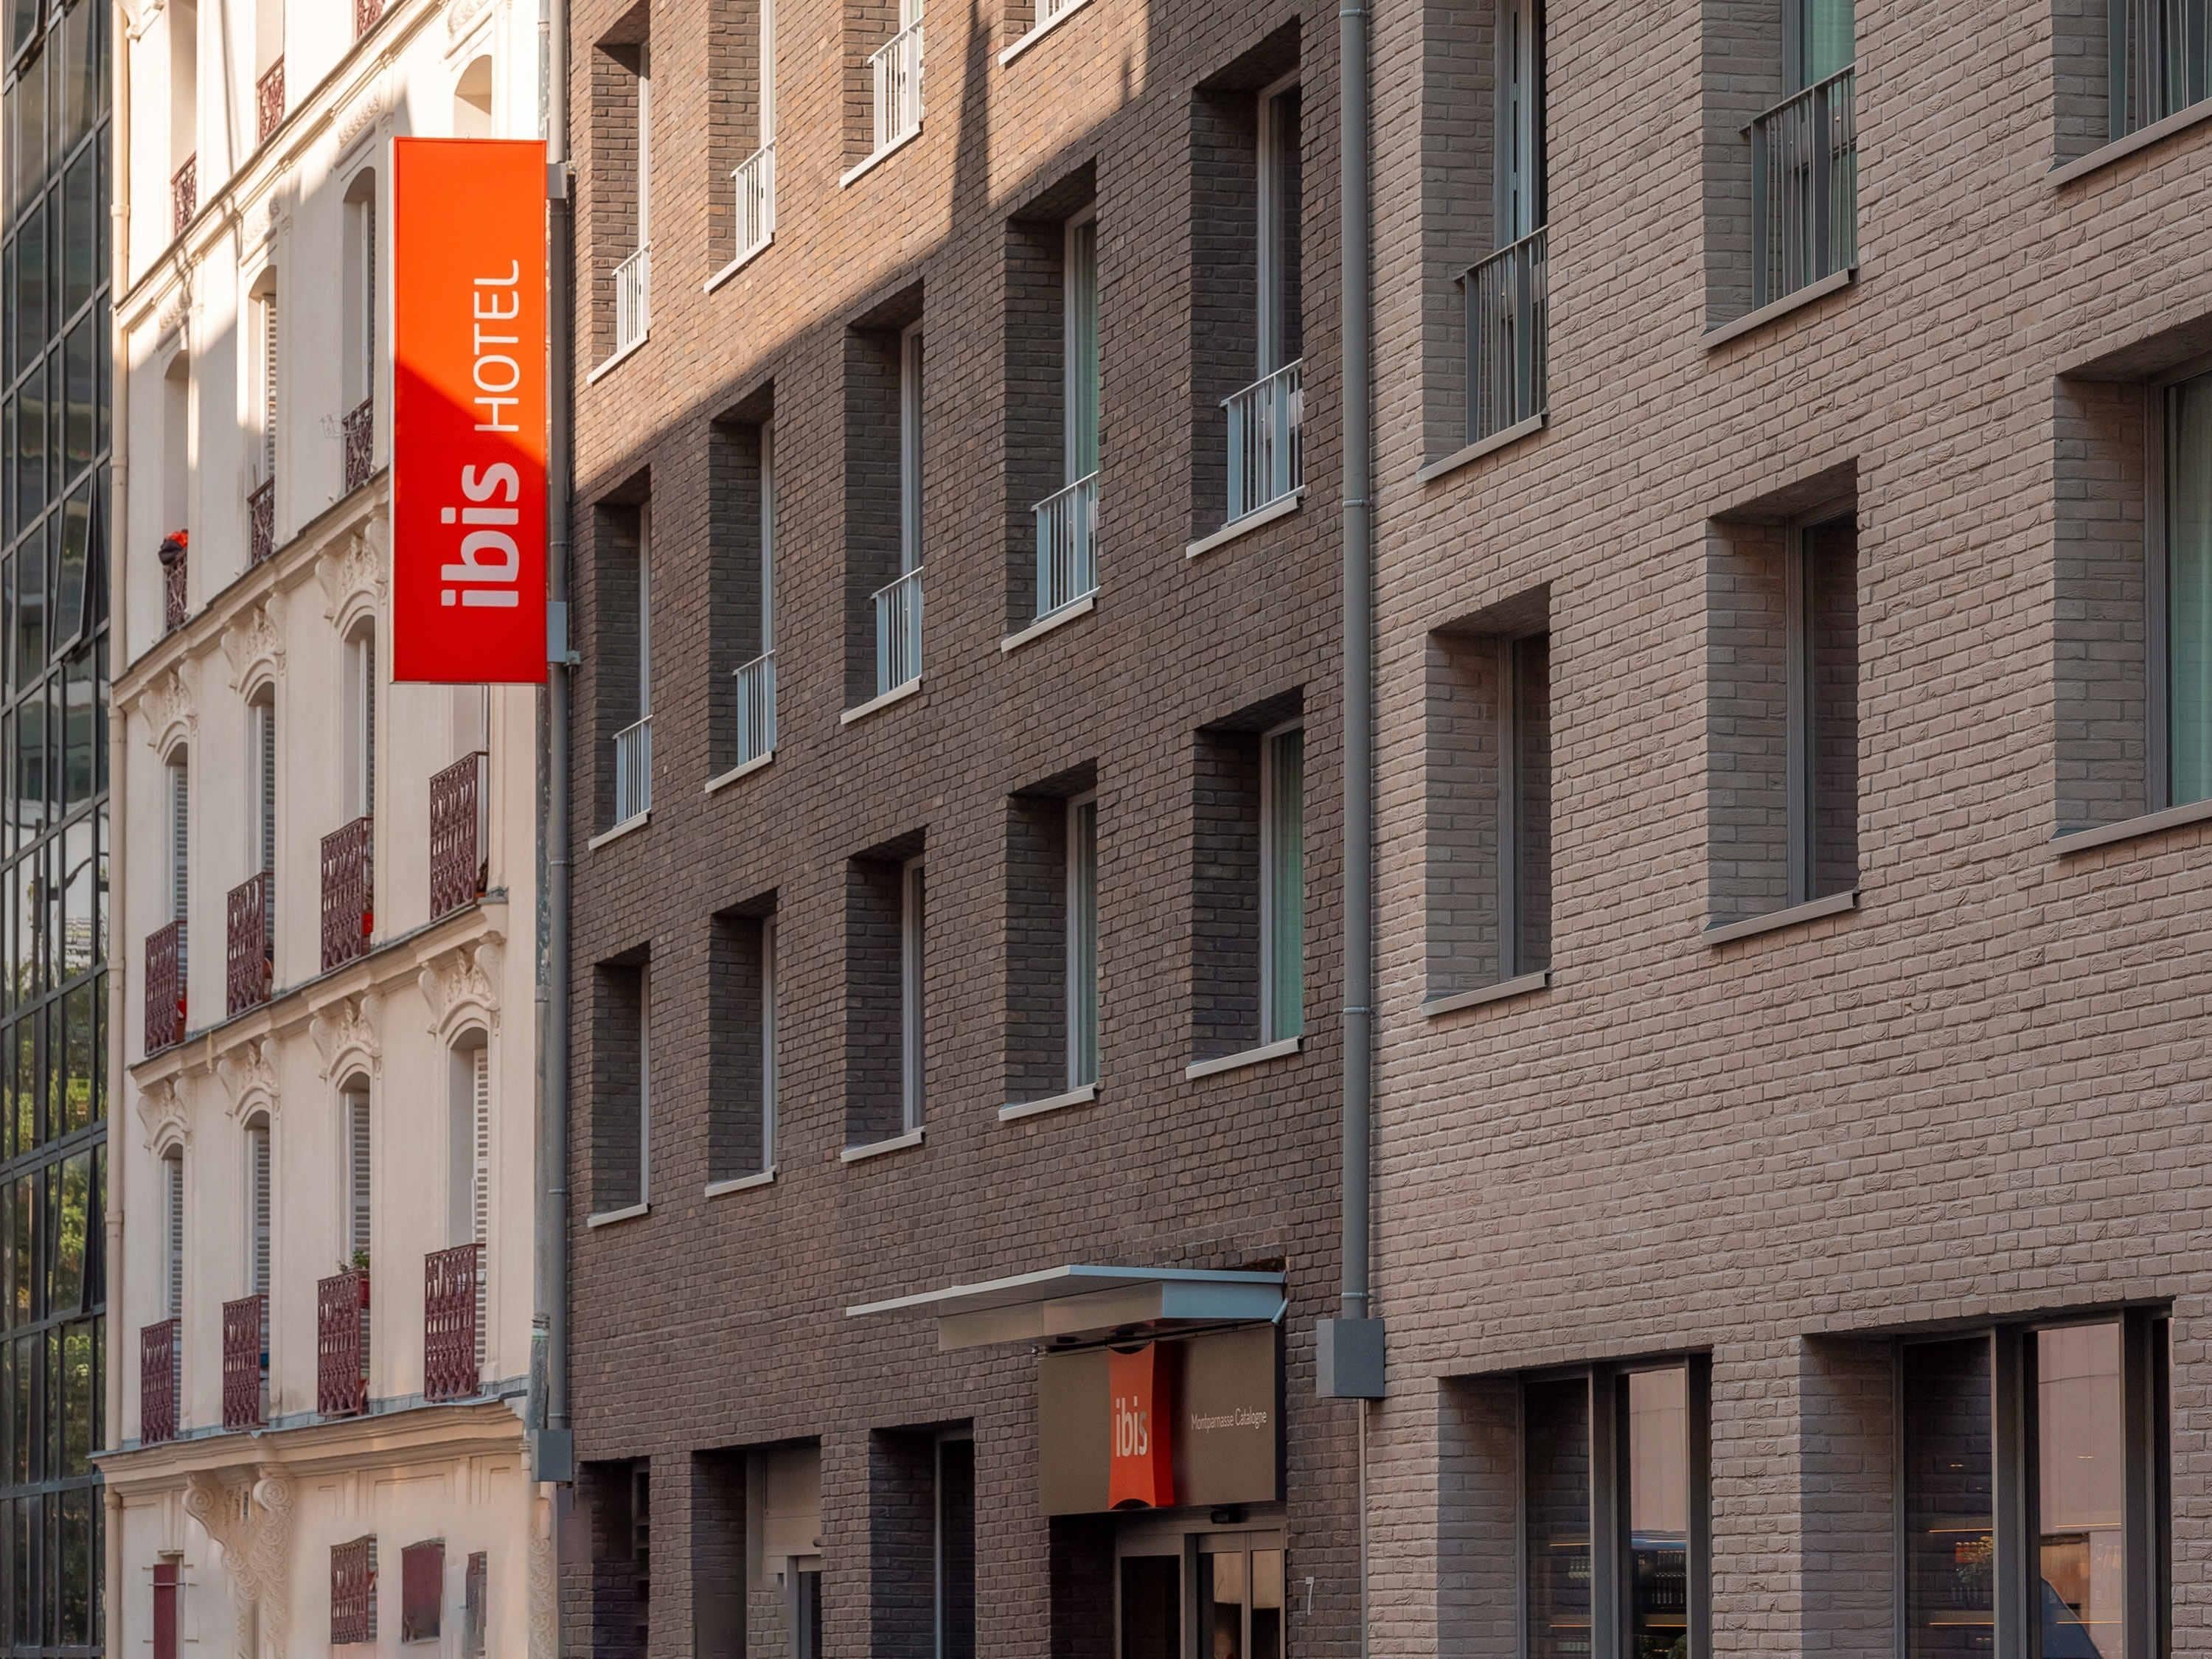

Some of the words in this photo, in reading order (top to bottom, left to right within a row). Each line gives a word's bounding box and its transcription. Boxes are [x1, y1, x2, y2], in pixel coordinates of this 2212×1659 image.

[473, 260, 519, 432] HOTEL
[441, 462, 519, 607] ibis
[1116, 1396, 1148, 1457] ibis
[1191, 1412, 1234, 1433] Montparnasse
[1235, 1405, 1267, 1429] Catalogne
